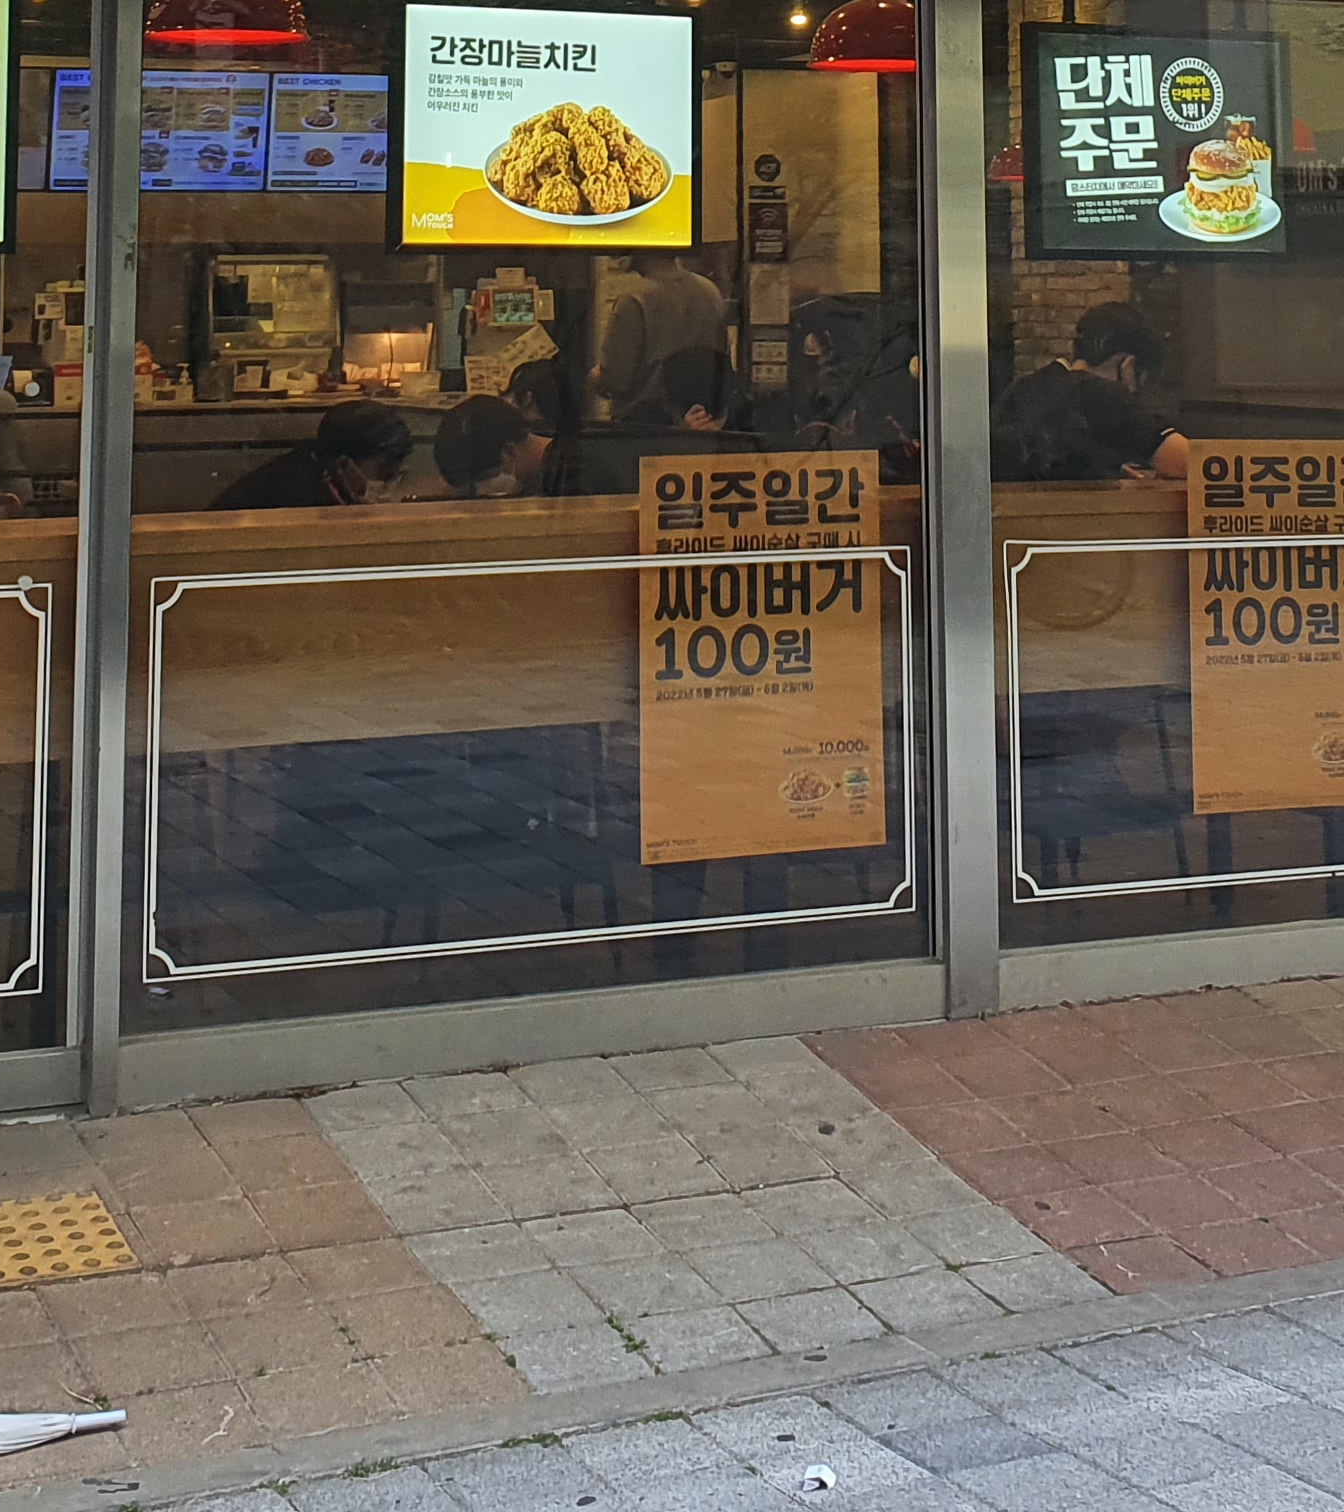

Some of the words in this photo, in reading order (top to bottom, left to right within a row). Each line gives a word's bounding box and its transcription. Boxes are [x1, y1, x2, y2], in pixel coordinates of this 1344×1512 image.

[429, 34, 598, 73] 간장마늘치킨
[1054, 54, 1155, 110] 단체
[1059, 115, 1159, 172] 주문
[655, 467, 865, 530] 일주일간
[654, 558, 863, 621] 싸이버거
[1204, 596, 1341, 646] 100원
[655, 624, 813, 681] 100원
